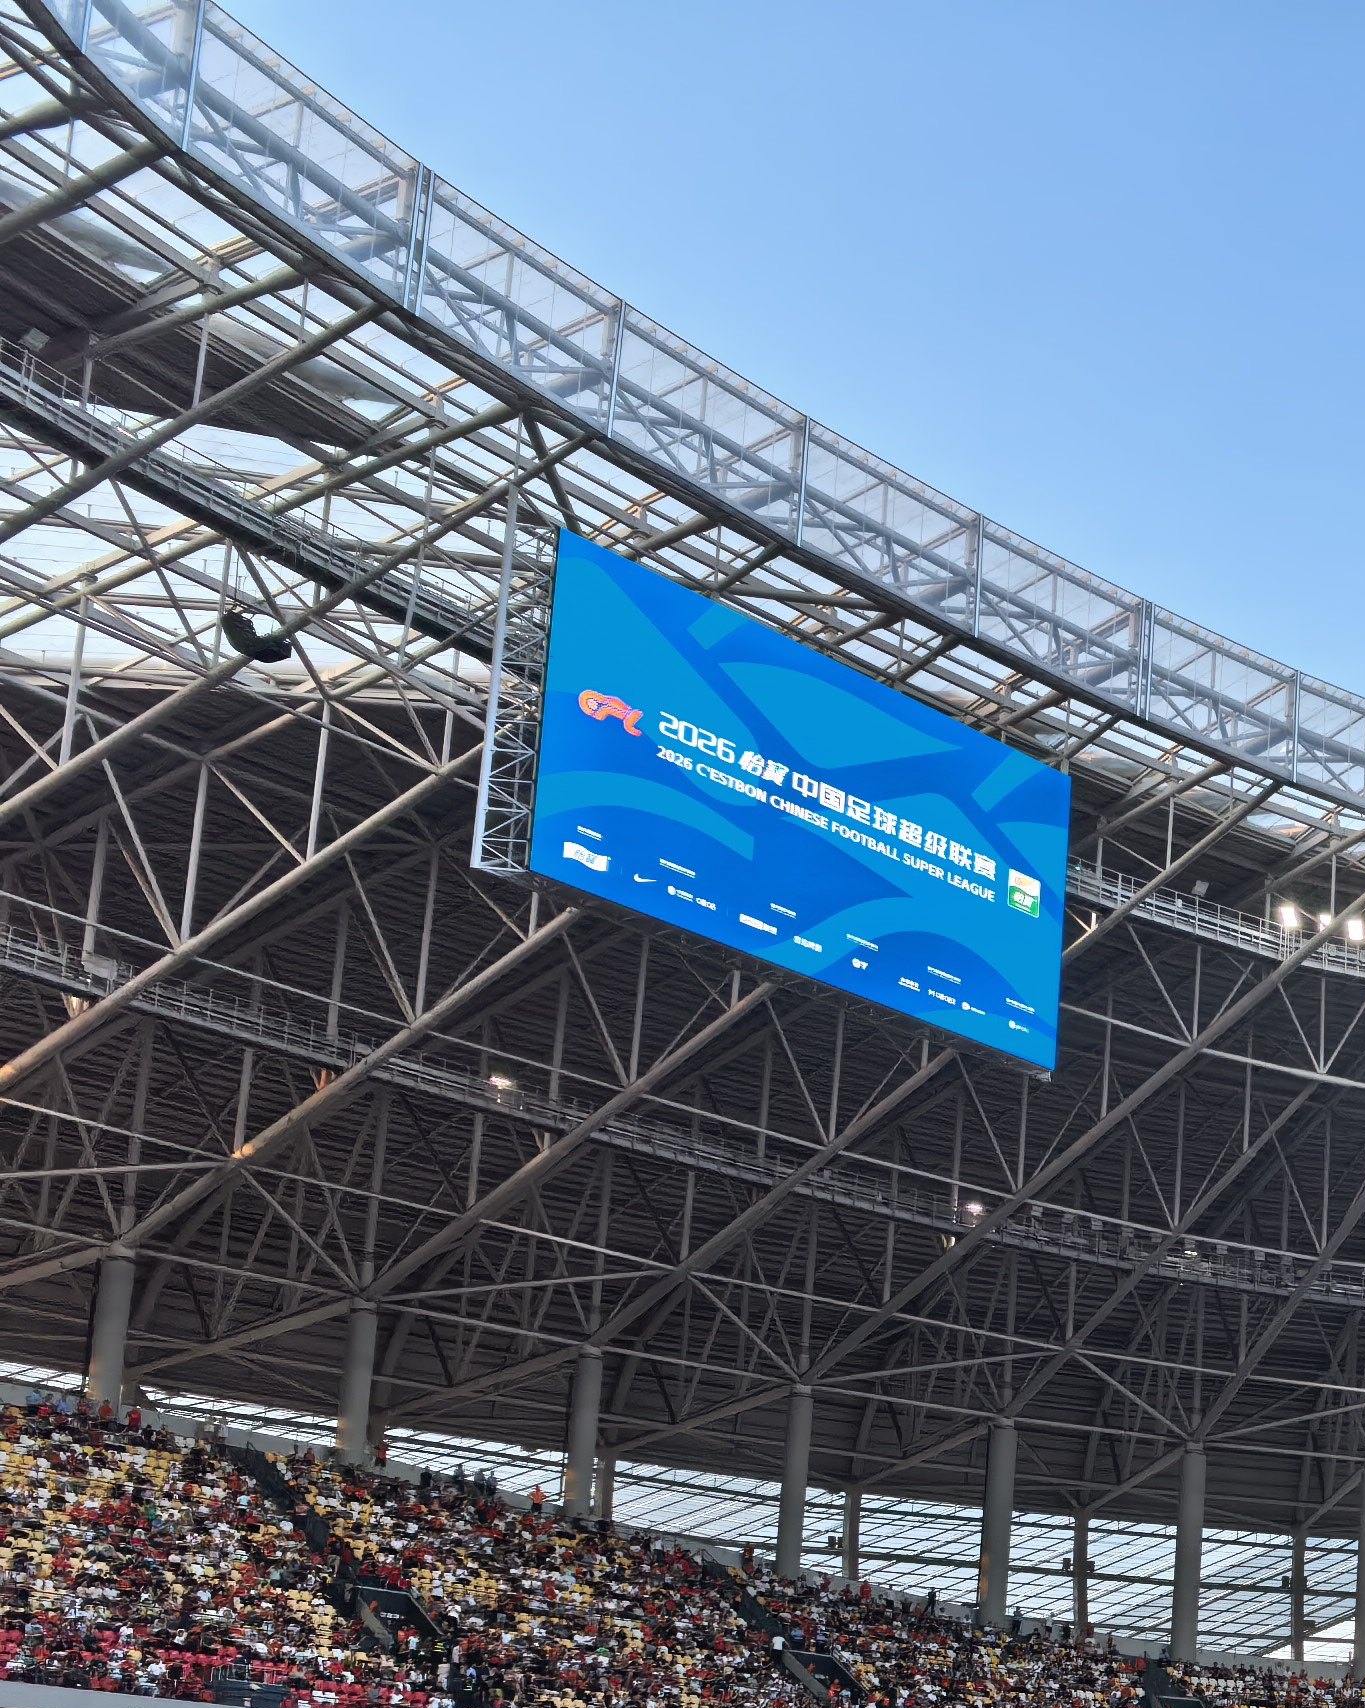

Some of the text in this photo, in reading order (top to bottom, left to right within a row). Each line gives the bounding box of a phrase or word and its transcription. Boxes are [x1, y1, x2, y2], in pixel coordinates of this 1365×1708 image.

[656, 745, 693, 771] 2026
[696, 763, 767, 803] C'ESTBON
[769, 795, 829, 830] CHINESE
[831, 821, 901, 861] FOOTBALL
[903, 852, 944, 880] SUPER
[947, 872, 996, 902] LEAGUE
[659, 711, 996, 881] 2026 怡寶 中国足球超级联赛
